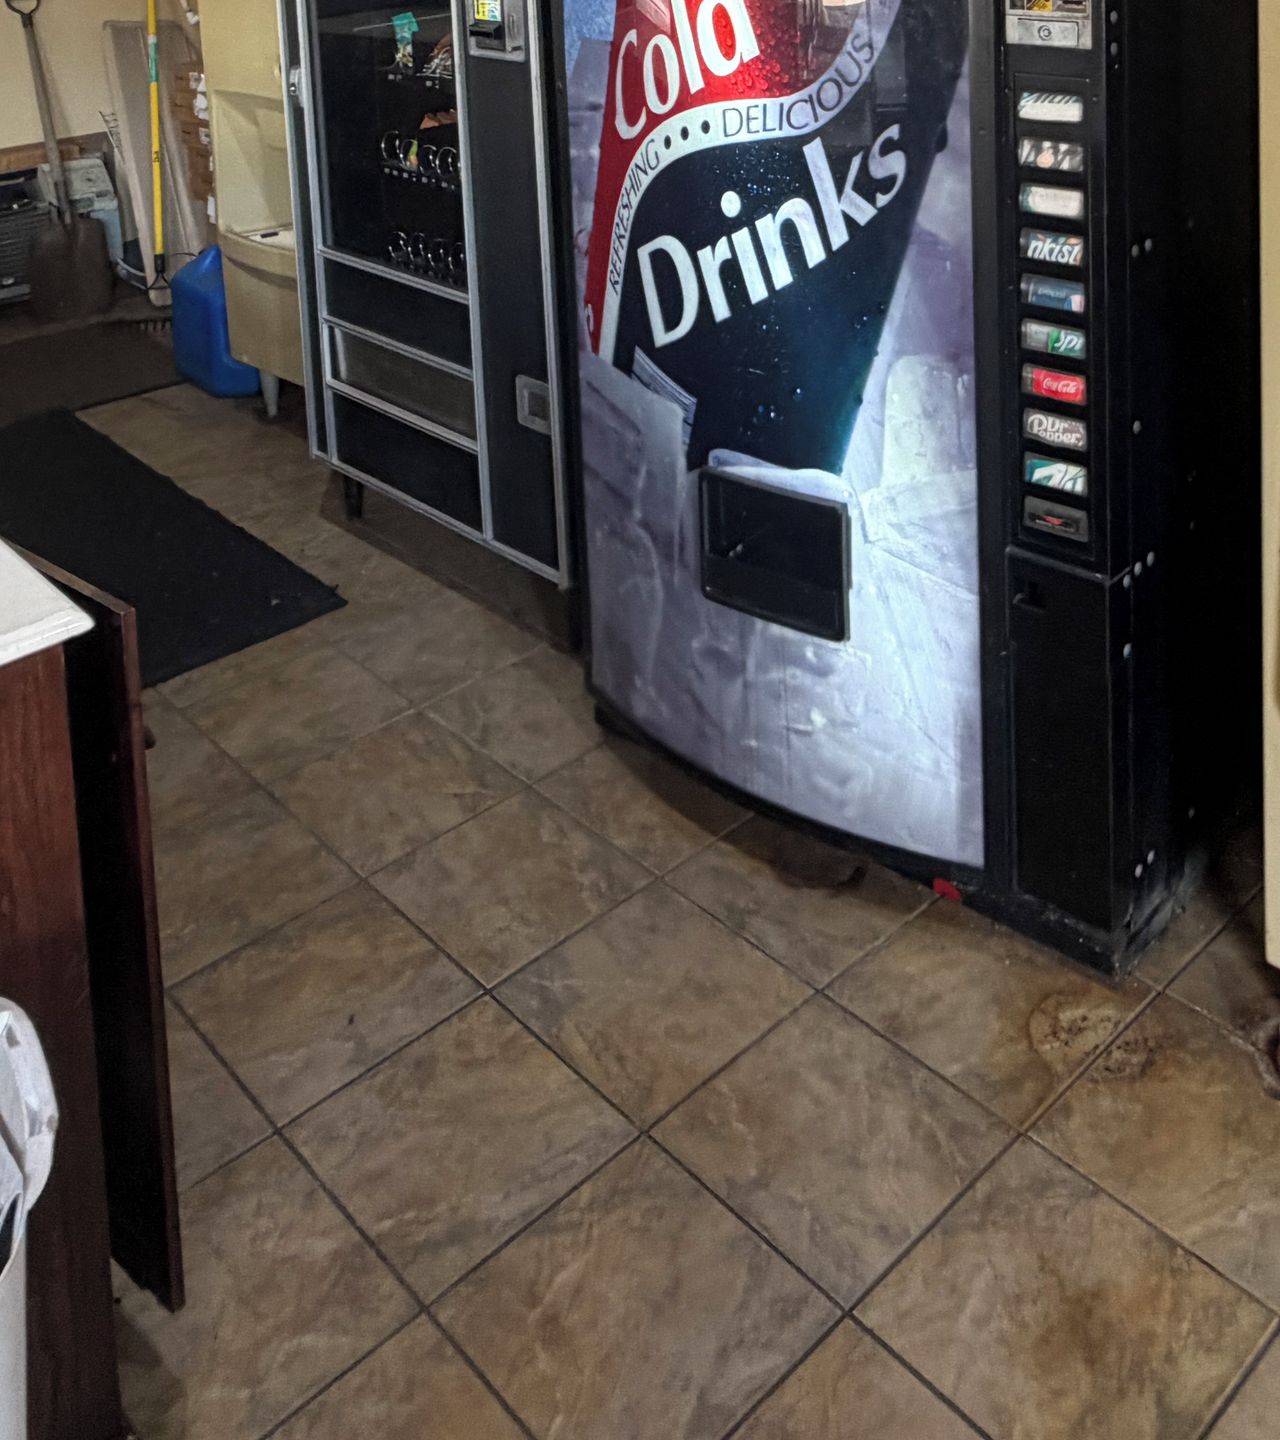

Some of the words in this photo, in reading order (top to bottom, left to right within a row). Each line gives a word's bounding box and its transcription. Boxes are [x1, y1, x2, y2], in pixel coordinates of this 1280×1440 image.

[608, 138, 661, 296] REFRESHING
[722, 31, 876, 138] DELICIOUS
[637, 123, 908, 349] Drinks
